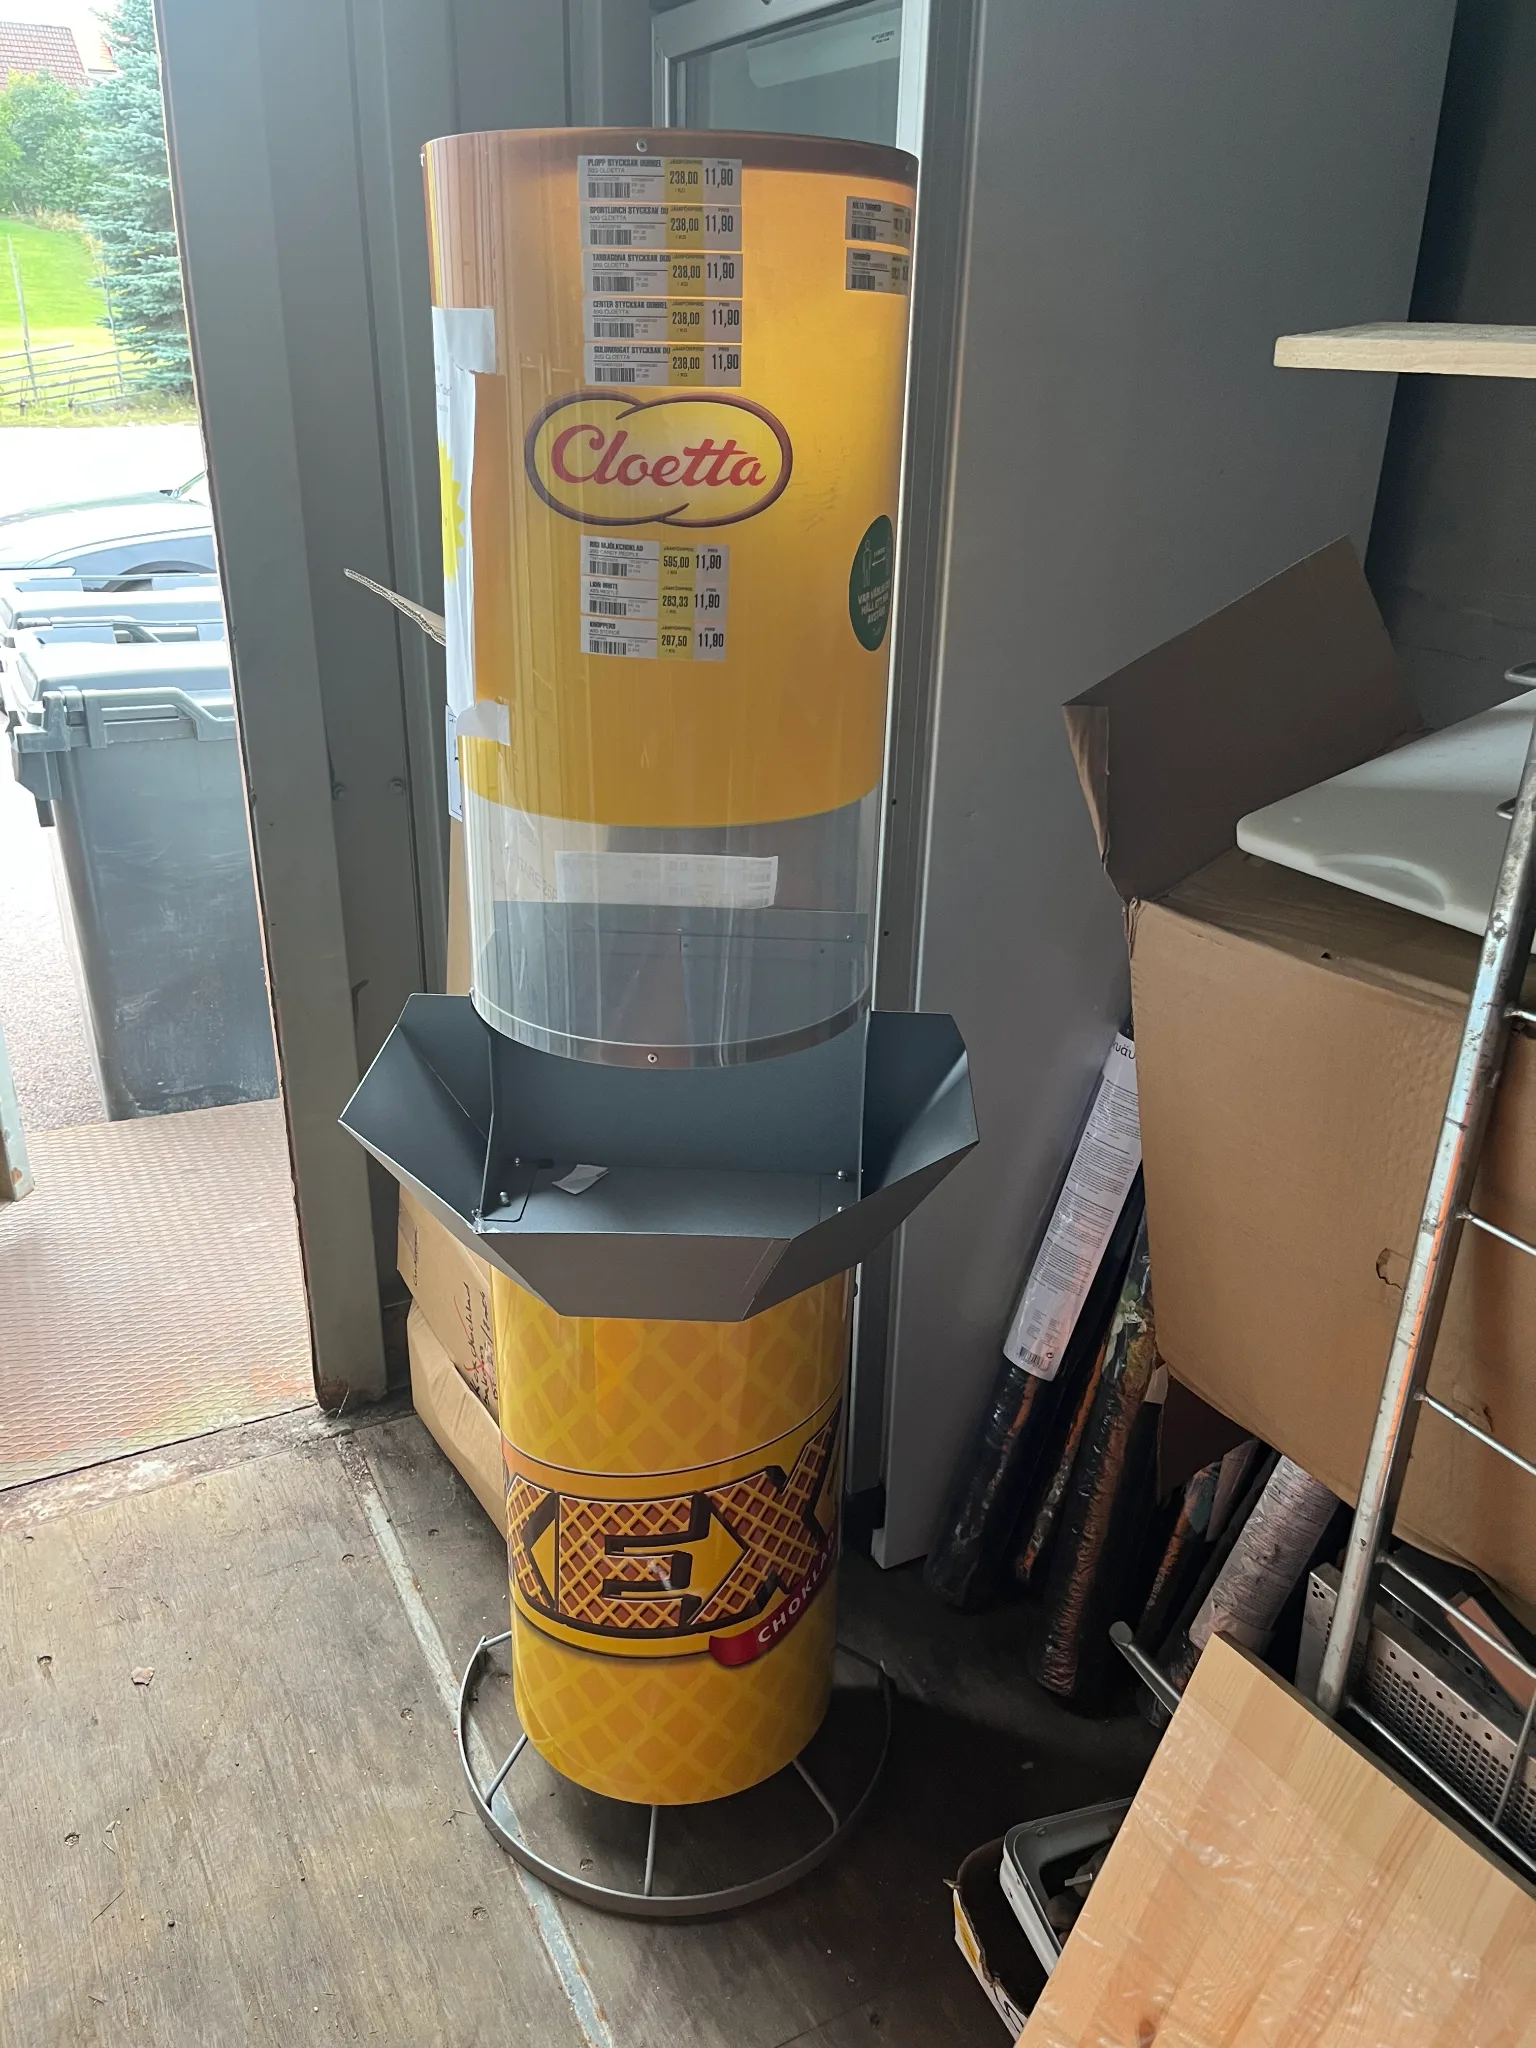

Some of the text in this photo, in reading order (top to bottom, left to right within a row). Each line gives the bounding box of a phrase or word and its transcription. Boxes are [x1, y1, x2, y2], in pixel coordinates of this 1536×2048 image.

[588, 159, 606, 167] PLOPP
[608, 159, 638, 167] STYCKSAK
[670, 170, 699, 187] 238,00
[705, 168, 733, 189] 11,90
[628, 207, 659, 215] STYCKSAK
[670, 217, 699, 234] 238,00
[705, 215, 734, 235] 11,90
[628, 254, 658, 262] STYCKSAK
[672, 265, 701, 281] 238,00
[707, 262, 735, 282] 11,90
[593, 300, 614, 308] CENTER
[615, 301, 645, 309] STYCKSAK
[672, 311, 700, 327] 238,00
[712, 309, 740, 329] 11,90
[672, 356, 700, 372] 238,00
[712, 354, 740, 373] 11,90
[551, 424, 767, 488] Cloetta
[663, 555, 690, 570] 595,00
[696, 554, 722, 571] 11,90
[662, 595, 689, 609] 283,33
[694, 593, 721, 611] 11,90
[590, 621, 616, 630] KNOPPERS
[698, 632, 725, 650] 11,90
